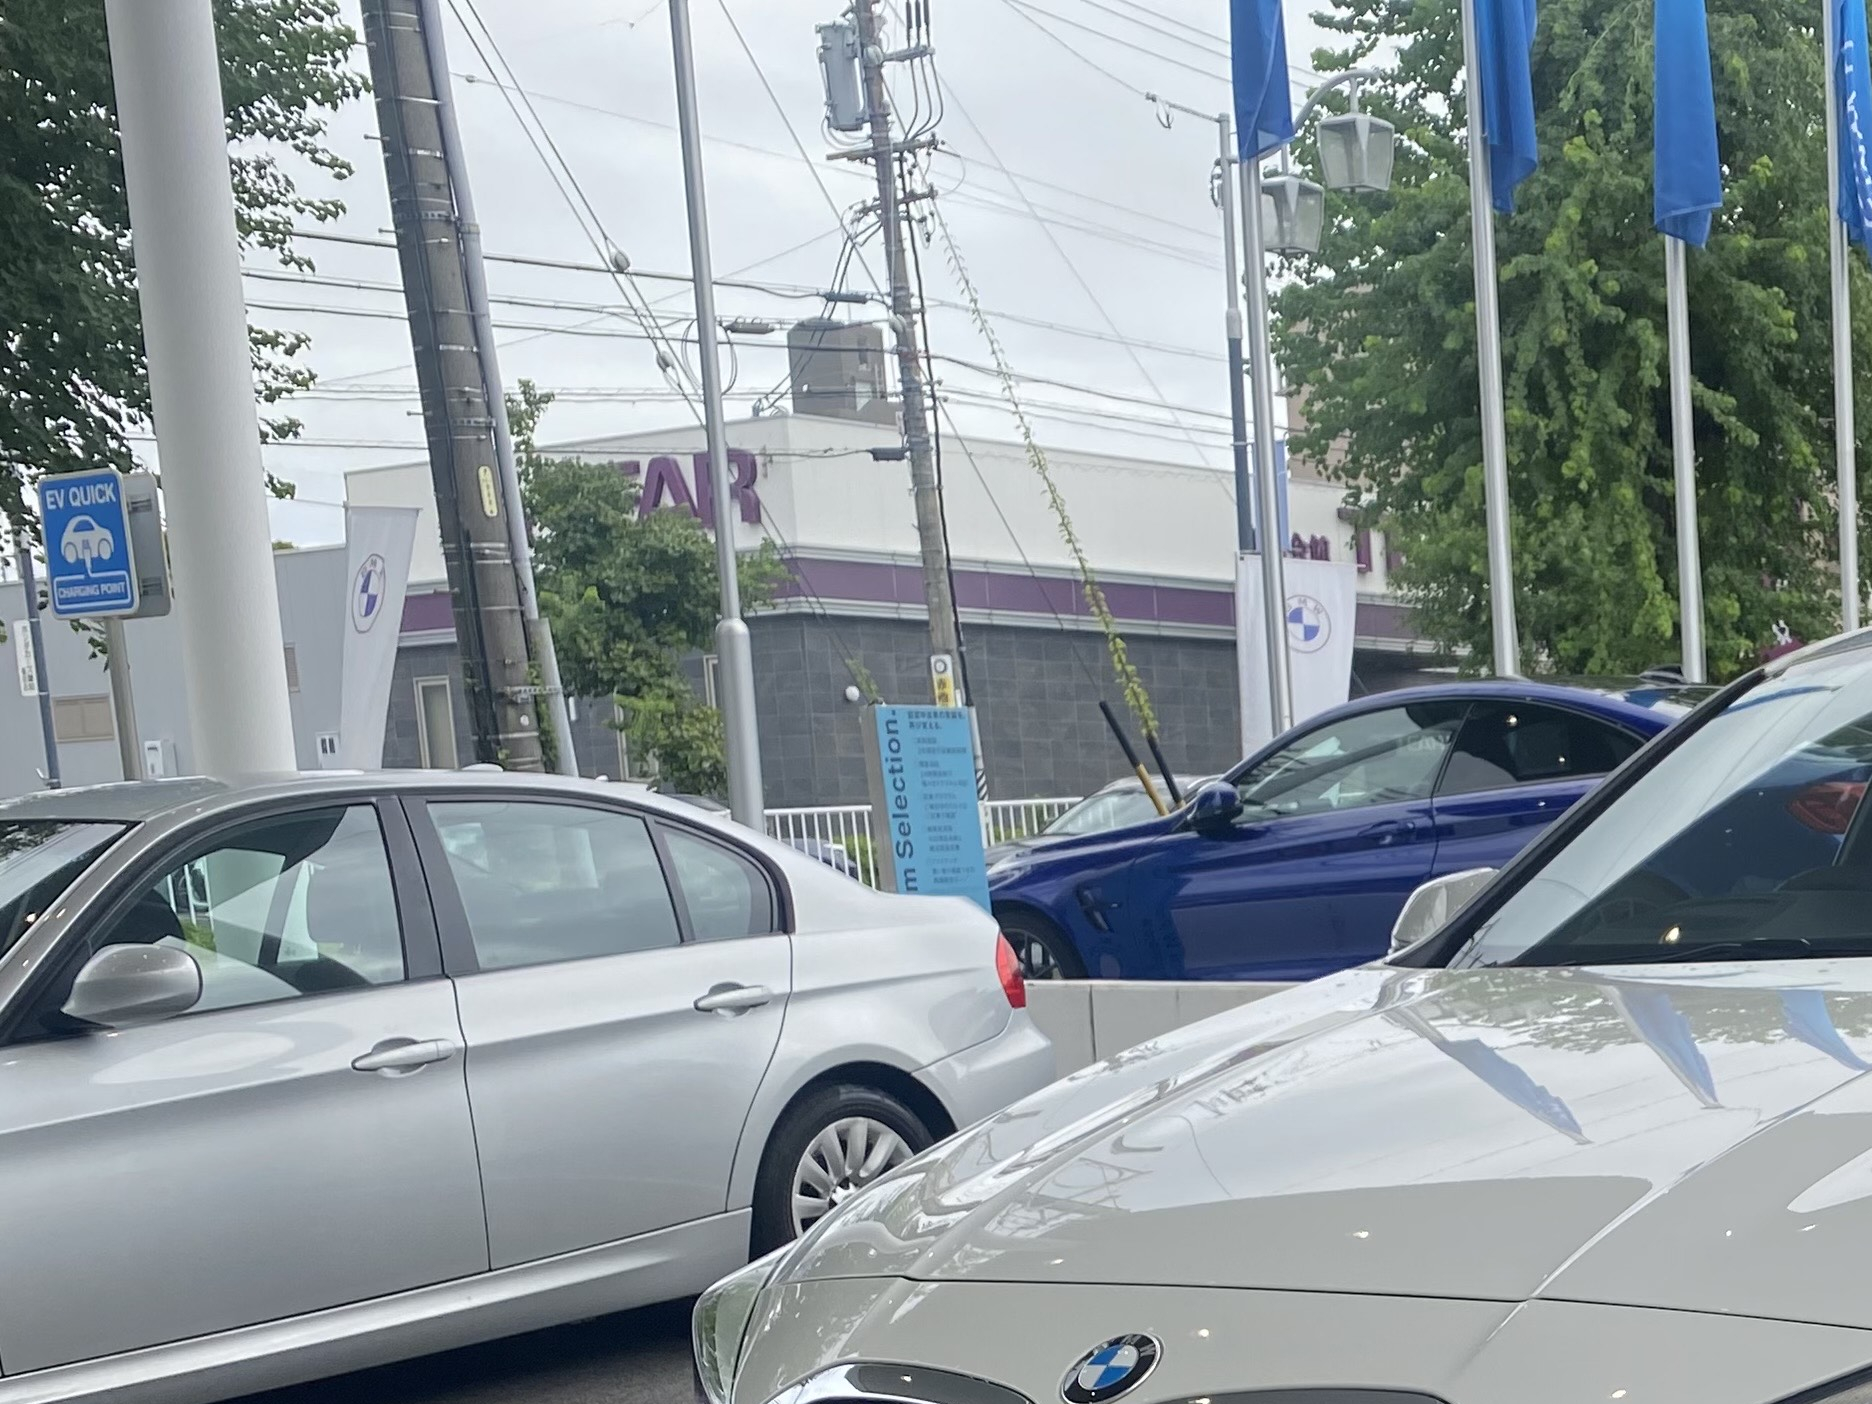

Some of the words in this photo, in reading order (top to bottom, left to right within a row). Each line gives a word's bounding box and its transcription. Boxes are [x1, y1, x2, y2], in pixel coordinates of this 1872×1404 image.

[46, 490, 64, 509] EV
[69, 482, 117, 508] QUICK
[58, 585, 100, 599] CHARGING
[100, 581, 126, 594] POINT
[885, 709, 914, 859] Selection.
